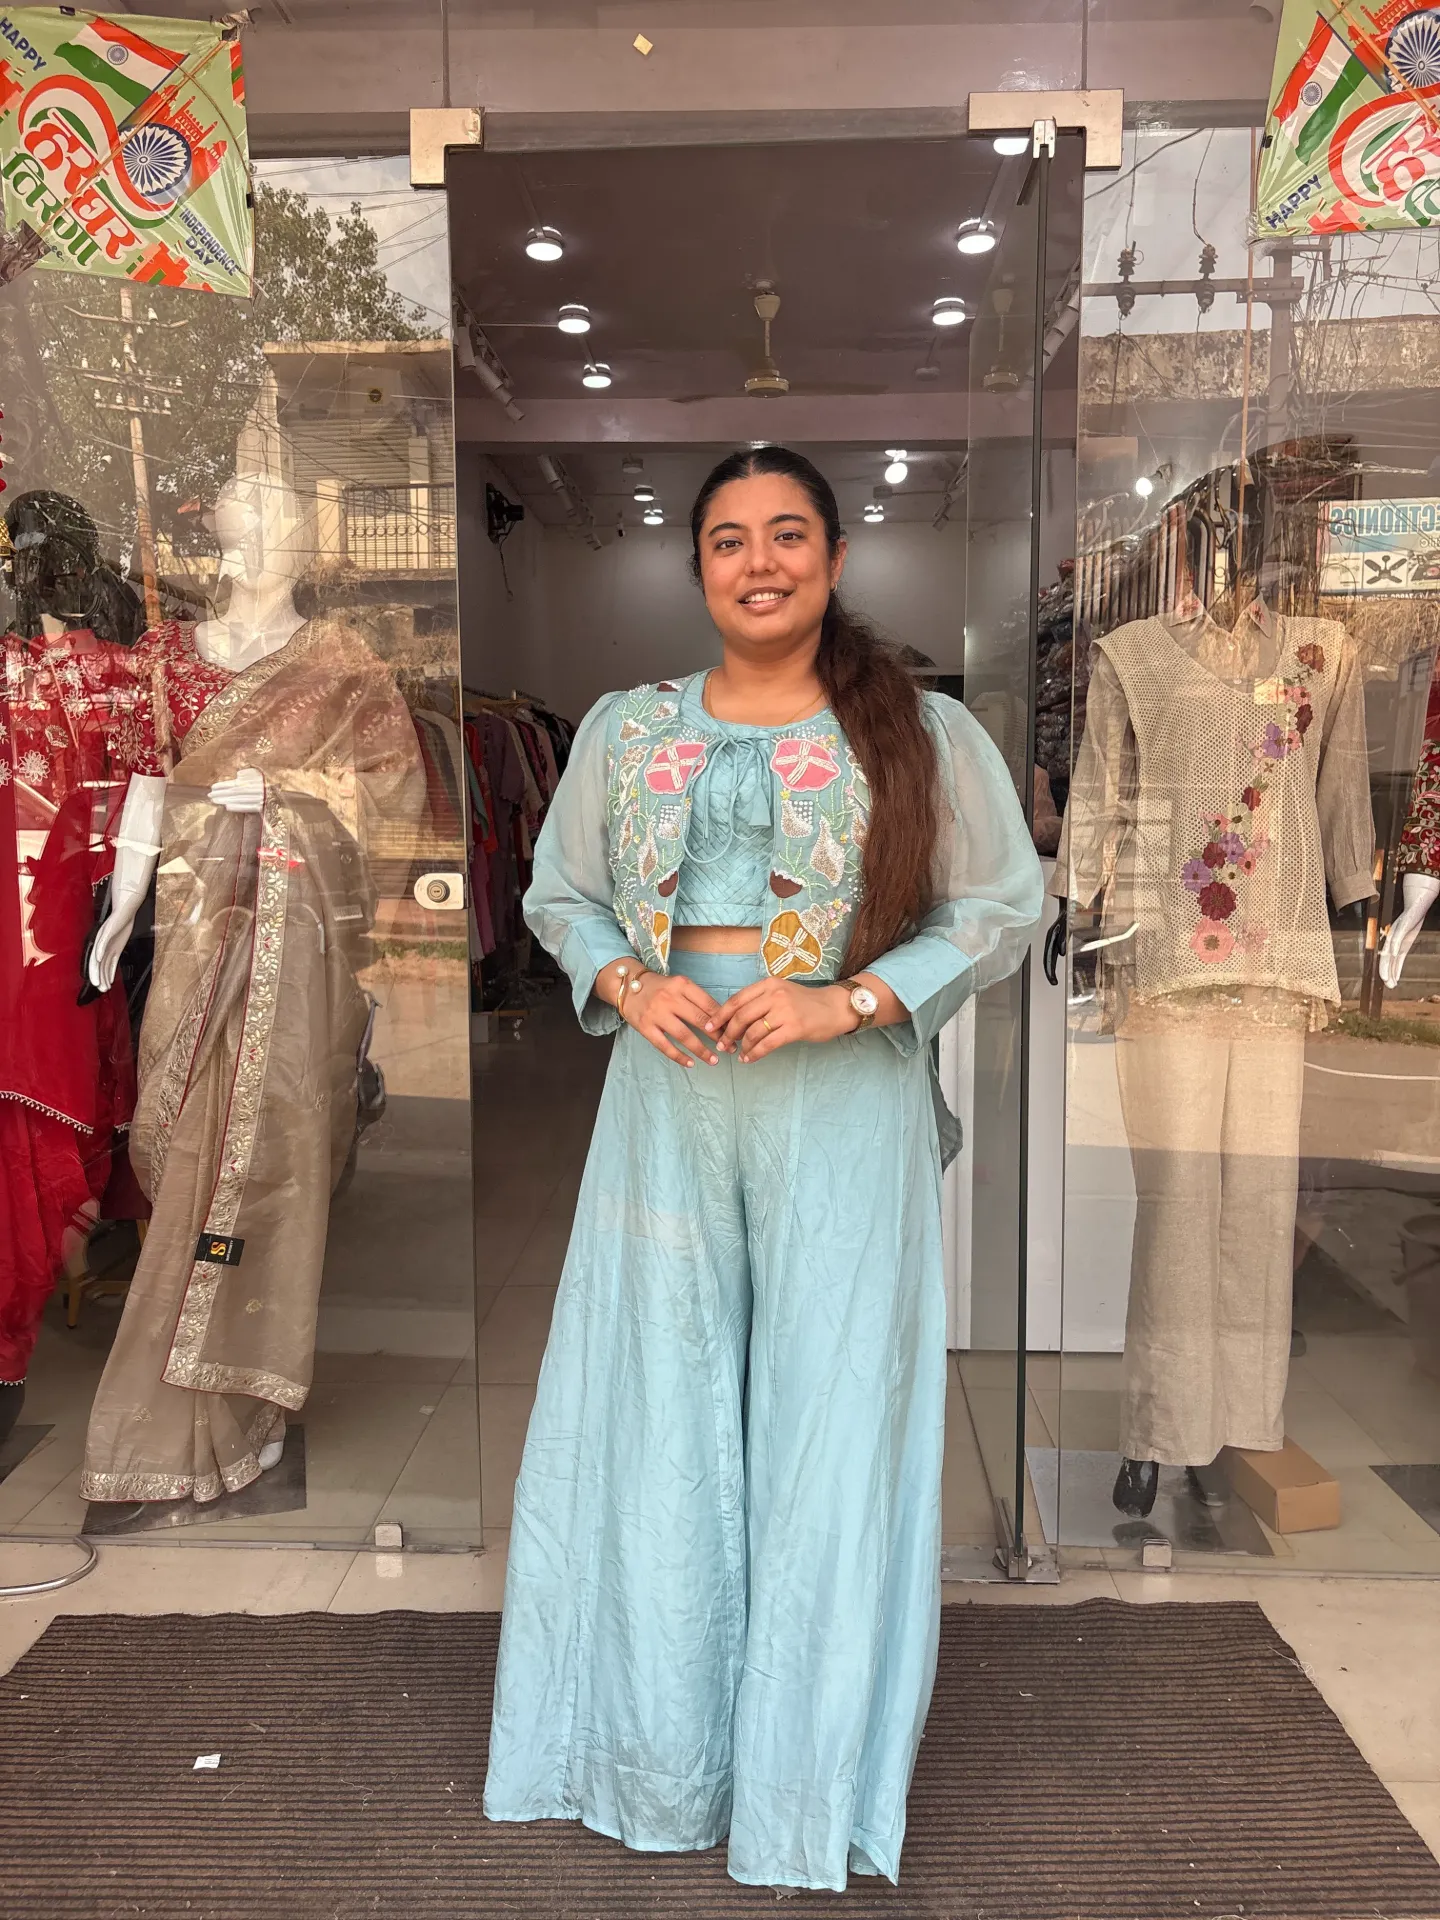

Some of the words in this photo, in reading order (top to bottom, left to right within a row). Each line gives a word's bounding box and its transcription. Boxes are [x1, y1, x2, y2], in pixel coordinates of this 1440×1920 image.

[0, 17, 47, 71] HAPPY
[2, 151, 102, 266] तिरंगा
[24, 112, 109, 195] हर
[72, 185, 142, 259] घर
[1265, 174, 1322, 229] HAPPY
[179, 208, 241, 276] INDEPENDENCE
[185, 236, 214, 266] DAY
